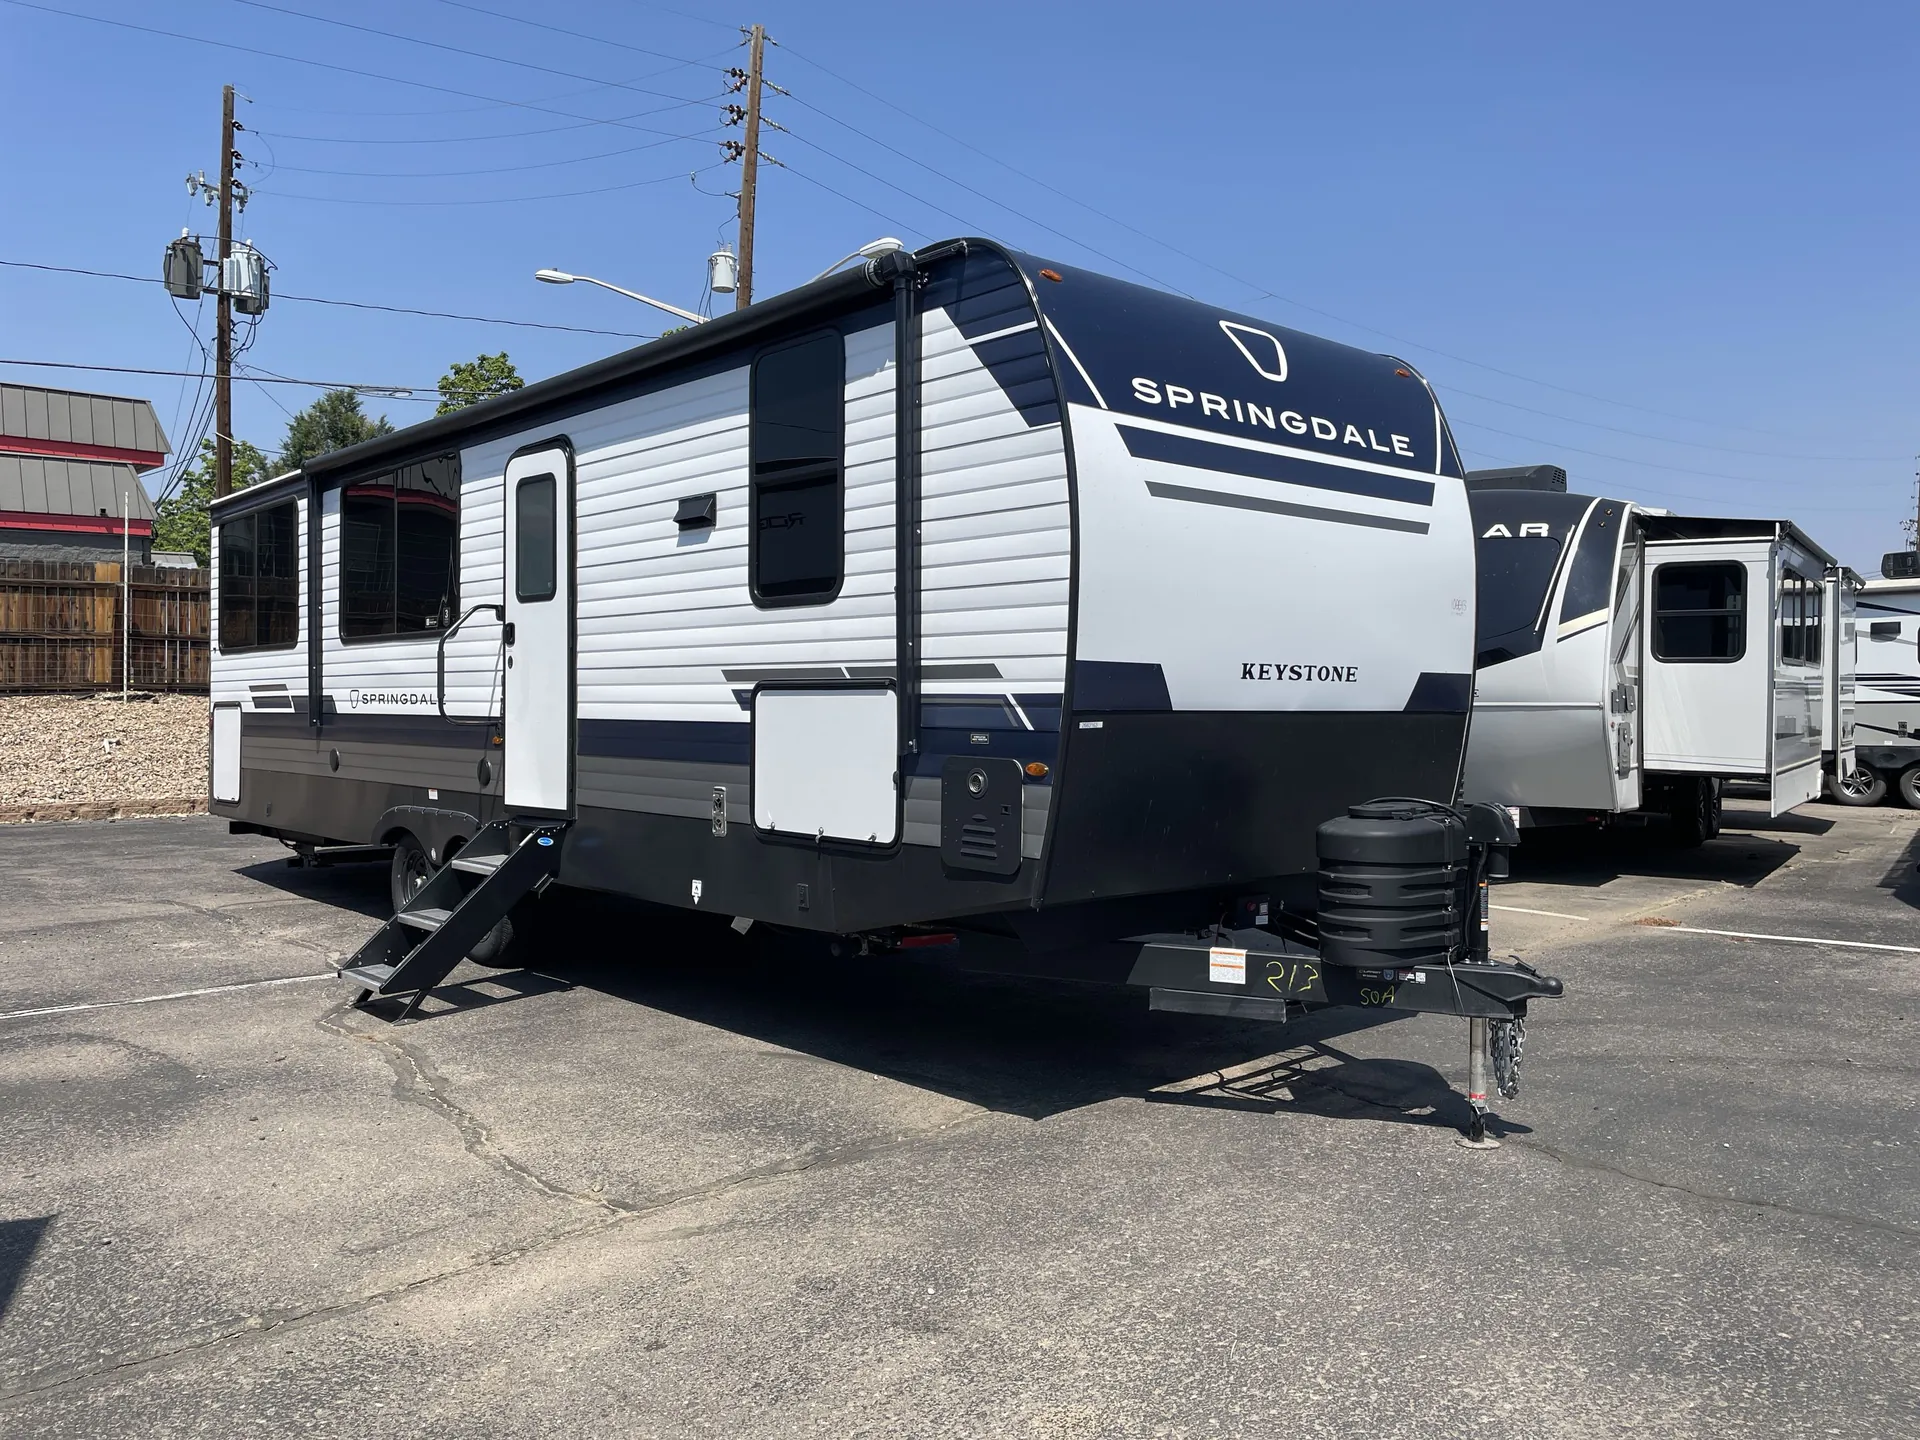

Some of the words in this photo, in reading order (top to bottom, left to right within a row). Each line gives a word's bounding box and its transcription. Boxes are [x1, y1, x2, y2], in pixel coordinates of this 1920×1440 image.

[1131, 377, 1415, 457] SPRINGDALE
[1481, 523, 1550, 538] AR
[1240, 662, 1359, 682] KEYSTONE
[1266, 961, 1319, 993] 213
